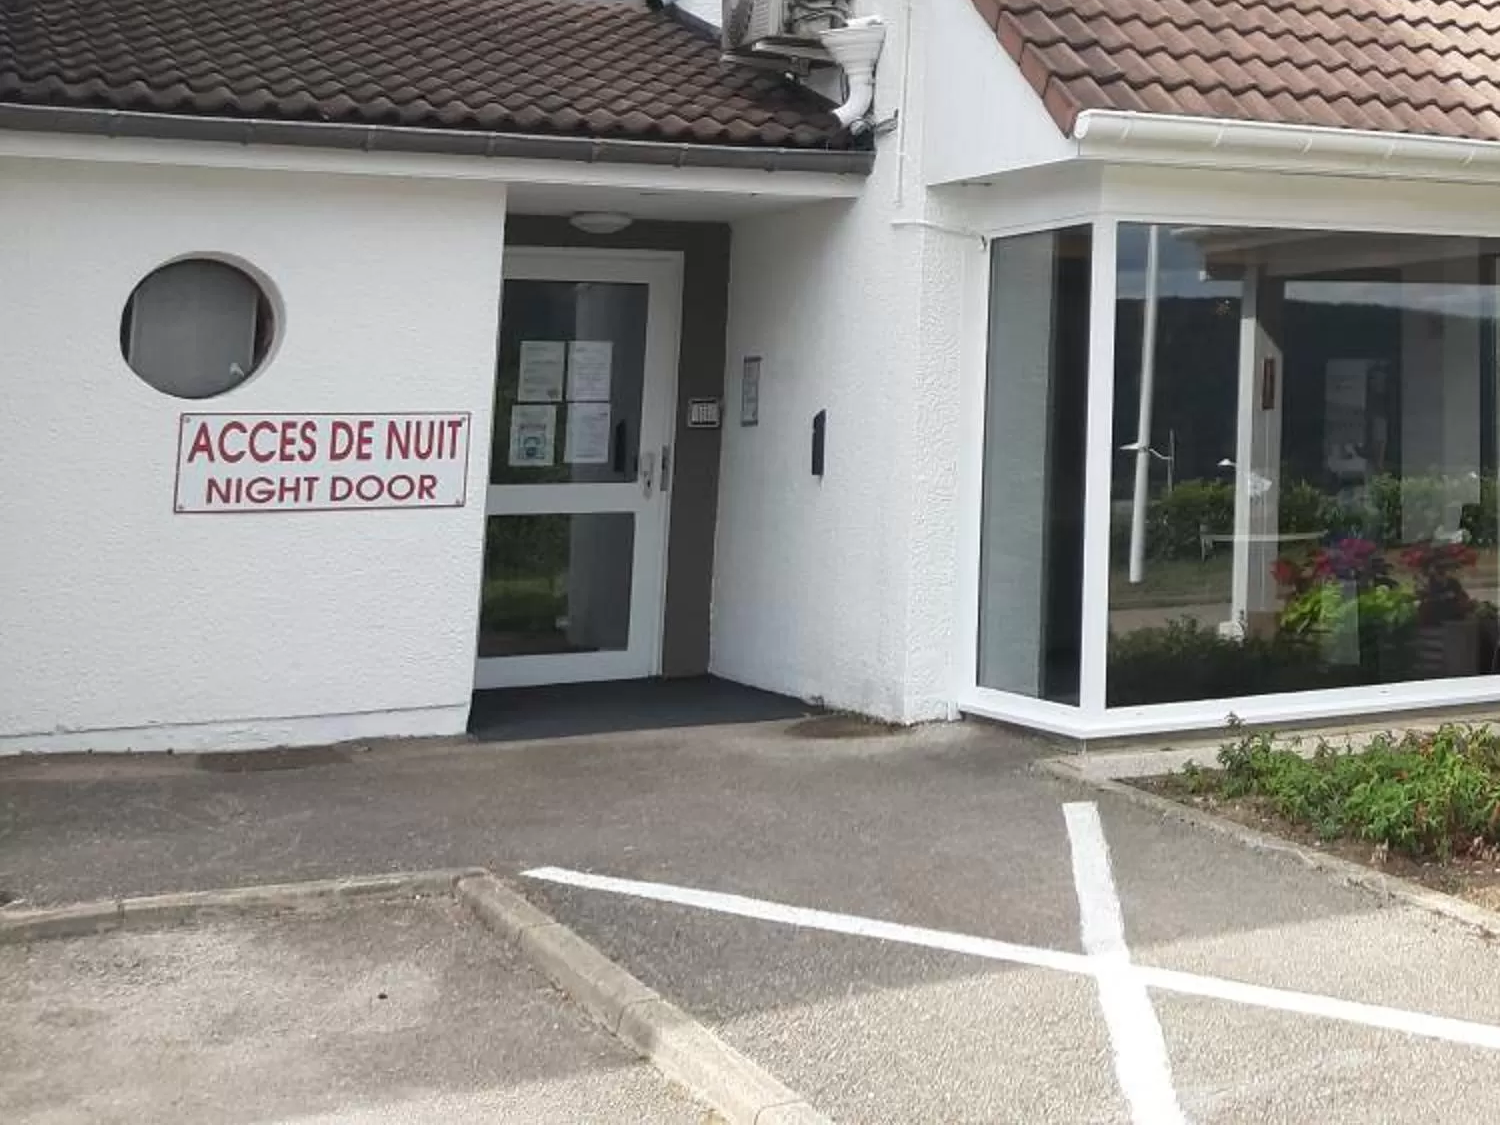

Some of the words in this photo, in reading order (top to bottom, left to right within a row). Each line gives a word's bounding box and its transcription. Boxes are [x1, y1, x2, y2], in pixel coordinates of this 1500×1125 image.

[186, 420, 318, 464] ACCES
[329, 420, 376, 462] DE
[385, 419, 464, 461] NUIT
[205, 475, 320, 504] NIGHT
[329, 473, 438, 503] DOOR
